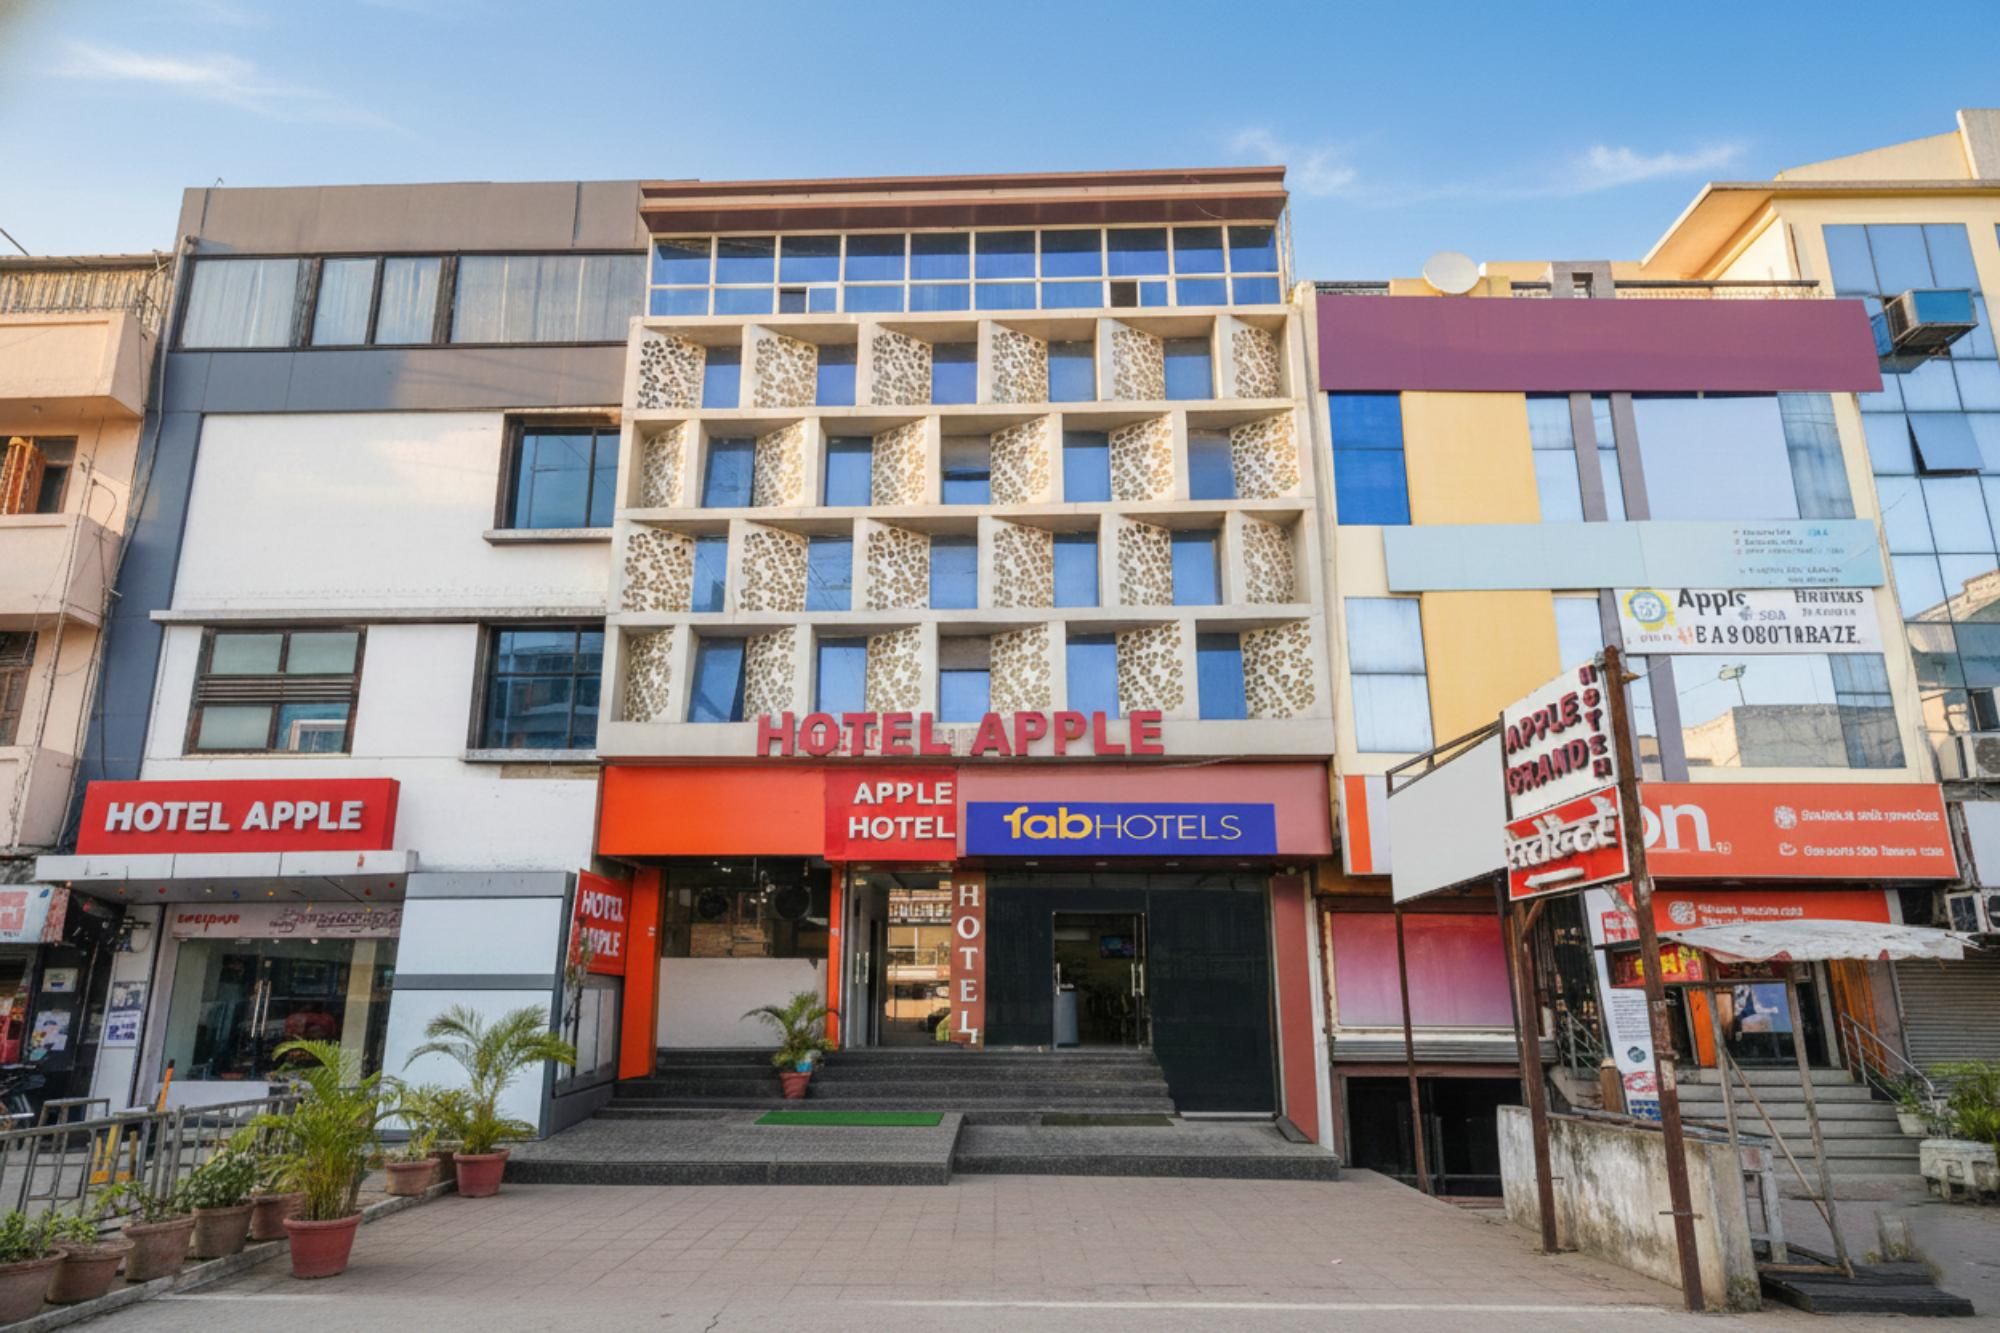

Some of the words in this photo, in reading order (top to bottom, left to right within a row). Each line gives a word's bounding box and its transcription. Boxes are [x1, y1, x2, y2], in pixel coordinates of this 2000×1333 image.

[756, 710, 952, 757] HOTEL
[970, 710, 1165, 756] APPLE
[1506, 691, 1583, 755] APPLE
[853, 781, 953, 805] APPLE
[104, 801, 231, 832] HOTEL
[241, 800, 364, 831] APPLE
[848, 816, 955, 841] HOTEL
[957, 884, 981, 1044] HOTEL
